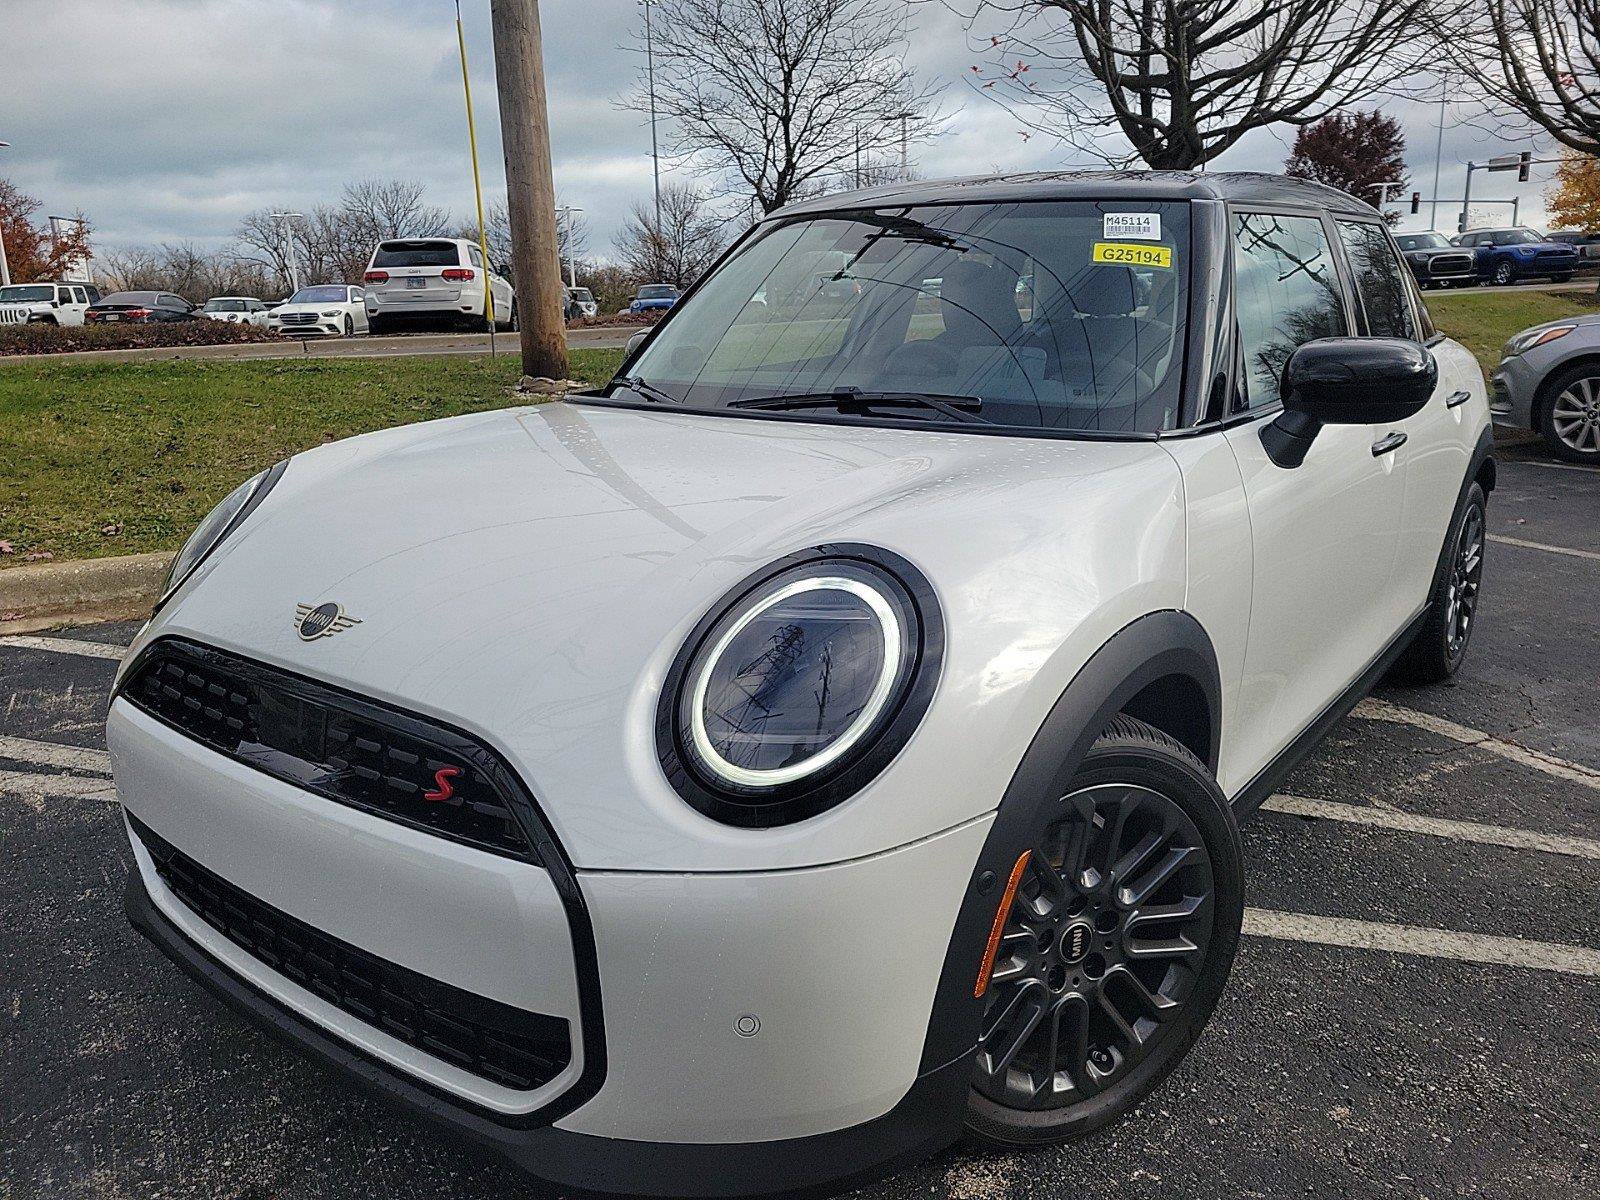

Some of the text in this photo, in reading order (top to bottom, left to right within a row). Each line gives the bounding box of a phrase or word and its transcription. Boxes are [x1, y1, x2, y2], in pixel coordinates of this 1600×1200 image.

[1106, 216, 1150, 226] M45114
[1102, 248, 1162, 264] G25194
[424, 768, 459, 801] S
[1072, 928, 1082, 957] MINI
